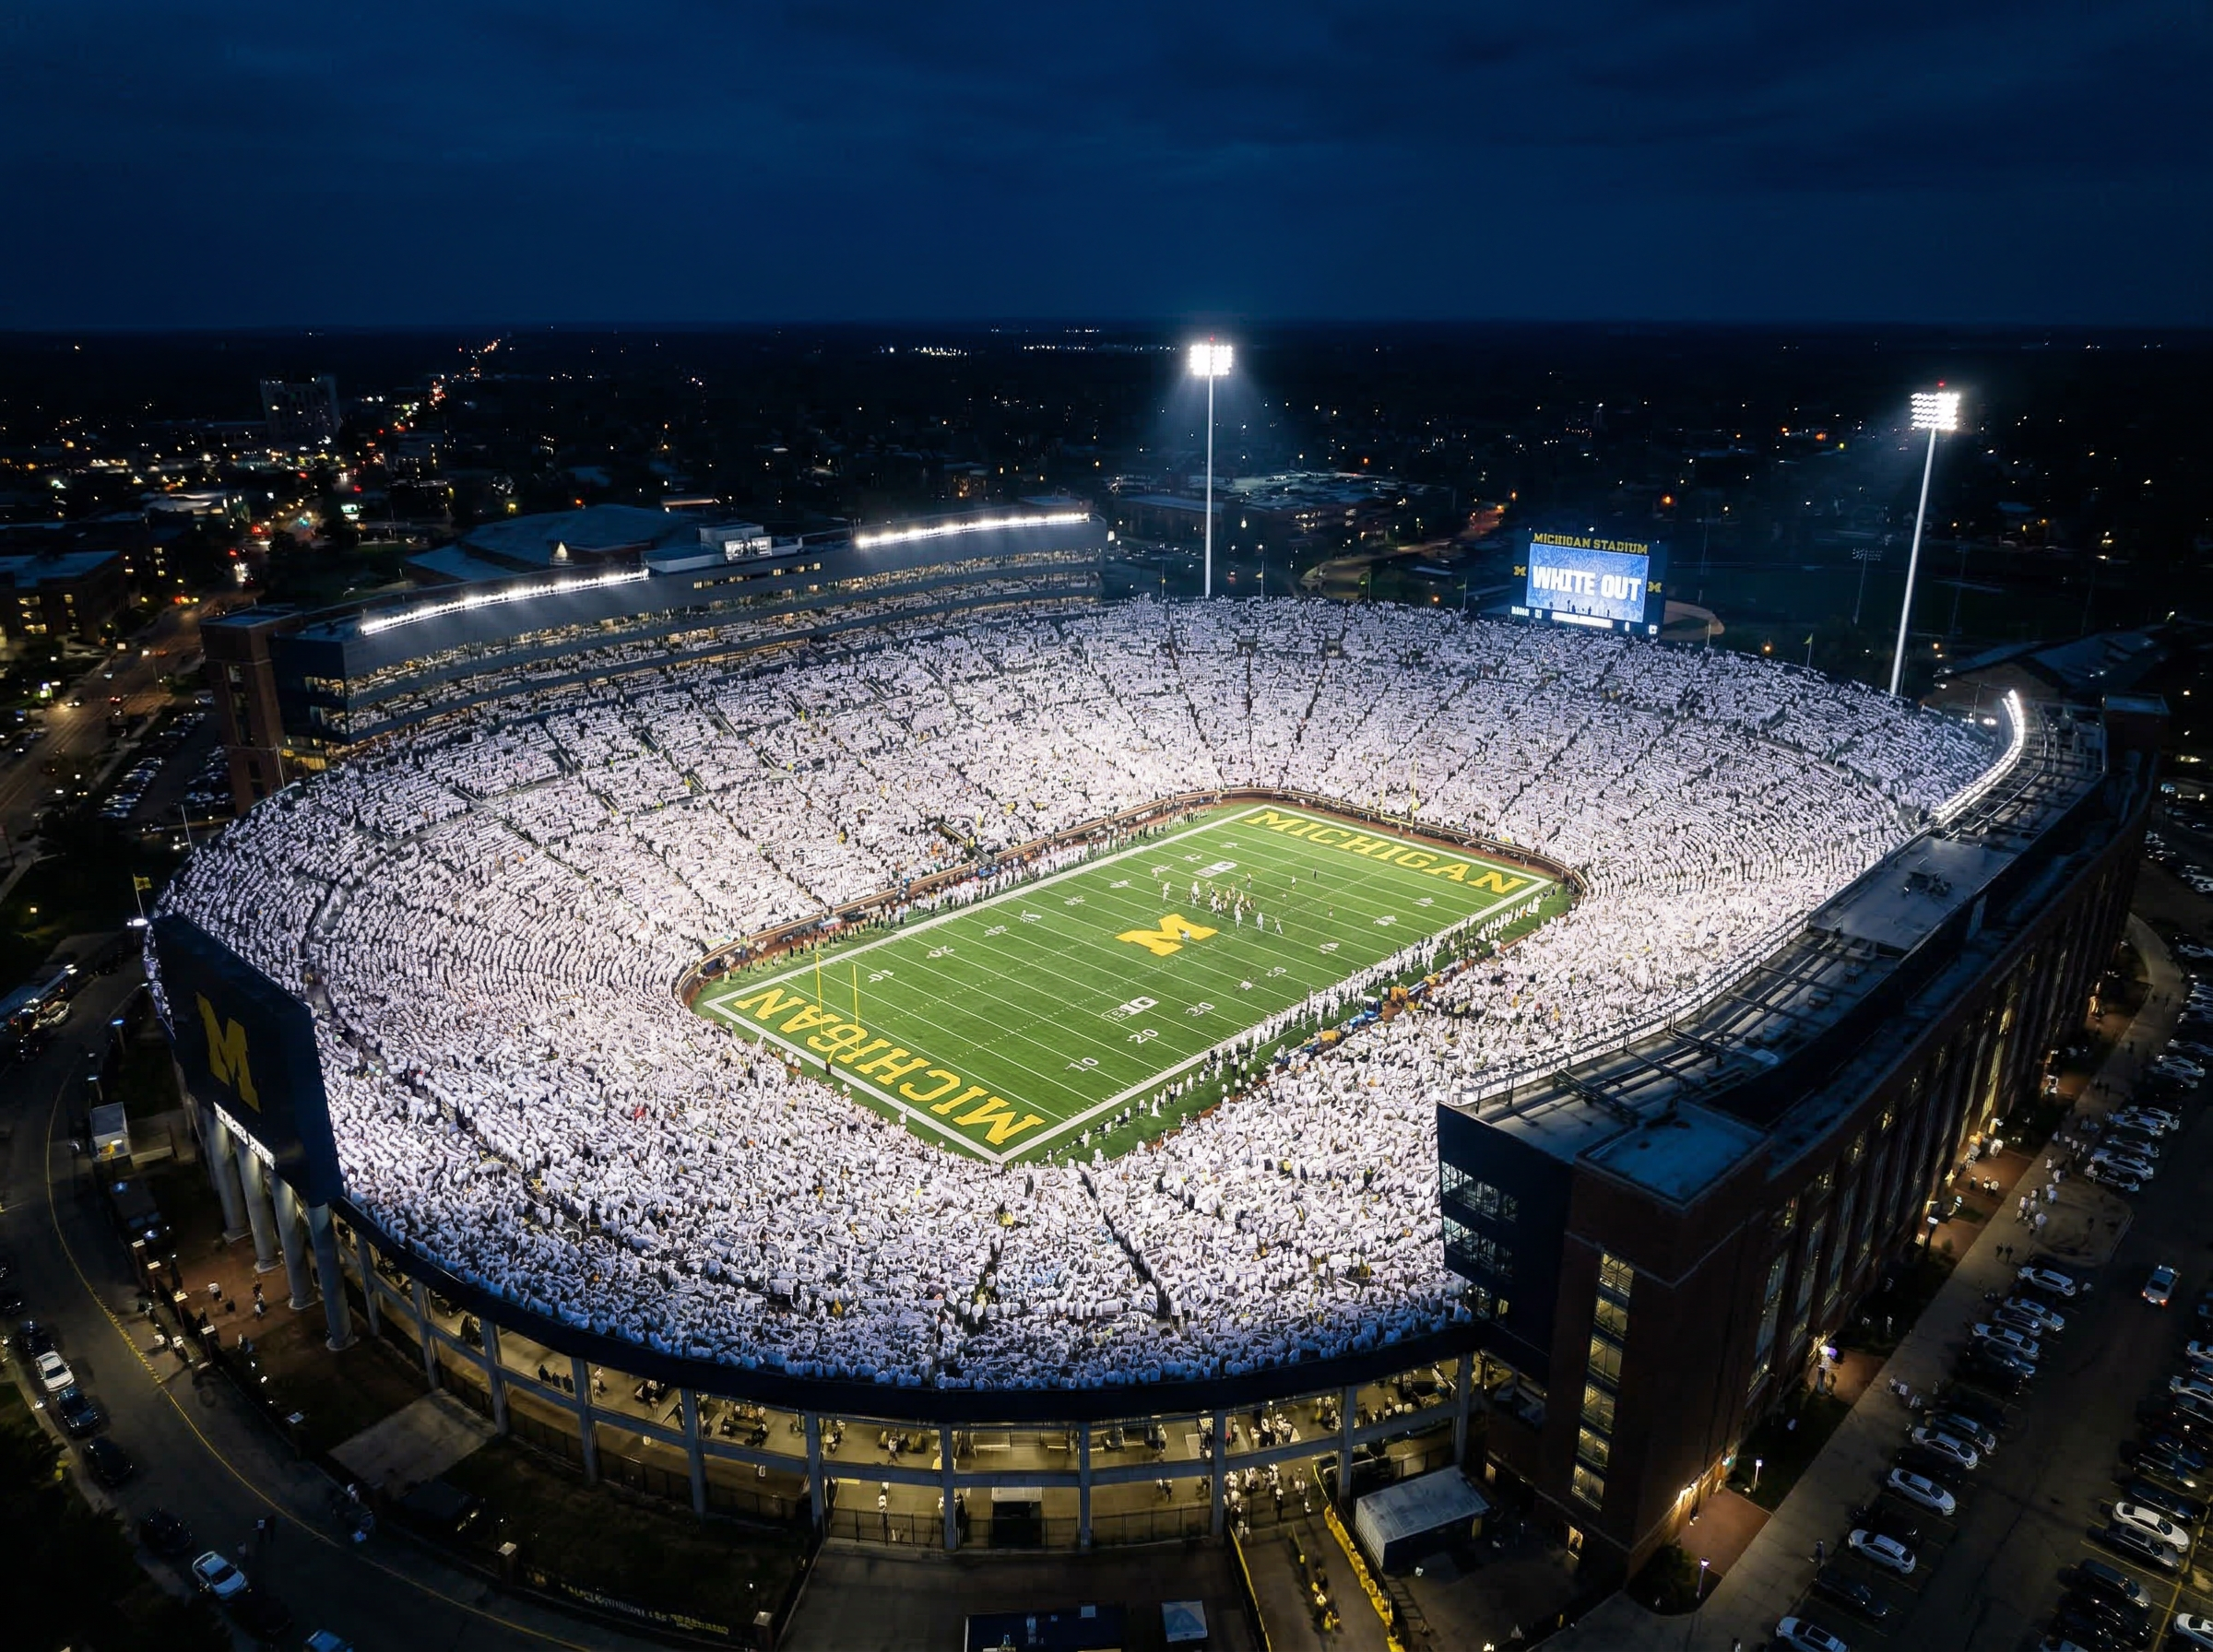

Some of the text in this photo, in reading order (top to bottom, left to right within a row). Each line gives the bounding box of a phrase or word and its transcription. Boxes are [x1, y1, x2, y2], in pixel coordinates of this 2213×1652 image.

[1593, 538, 1648, 555] STADIUM
[1533, 565, 1641, 602] WHITE OUT
[1244, 811, 1528, 893] MICHIGAN
[1115, 913, 1218, 957] M
[195, 992, 261, 1115] M
[1127, 1029, 1159, 1044] 20
[733, 987, 1047, 1146] MICHIGAN
[1064, 1056, 1100, 1072] 10
